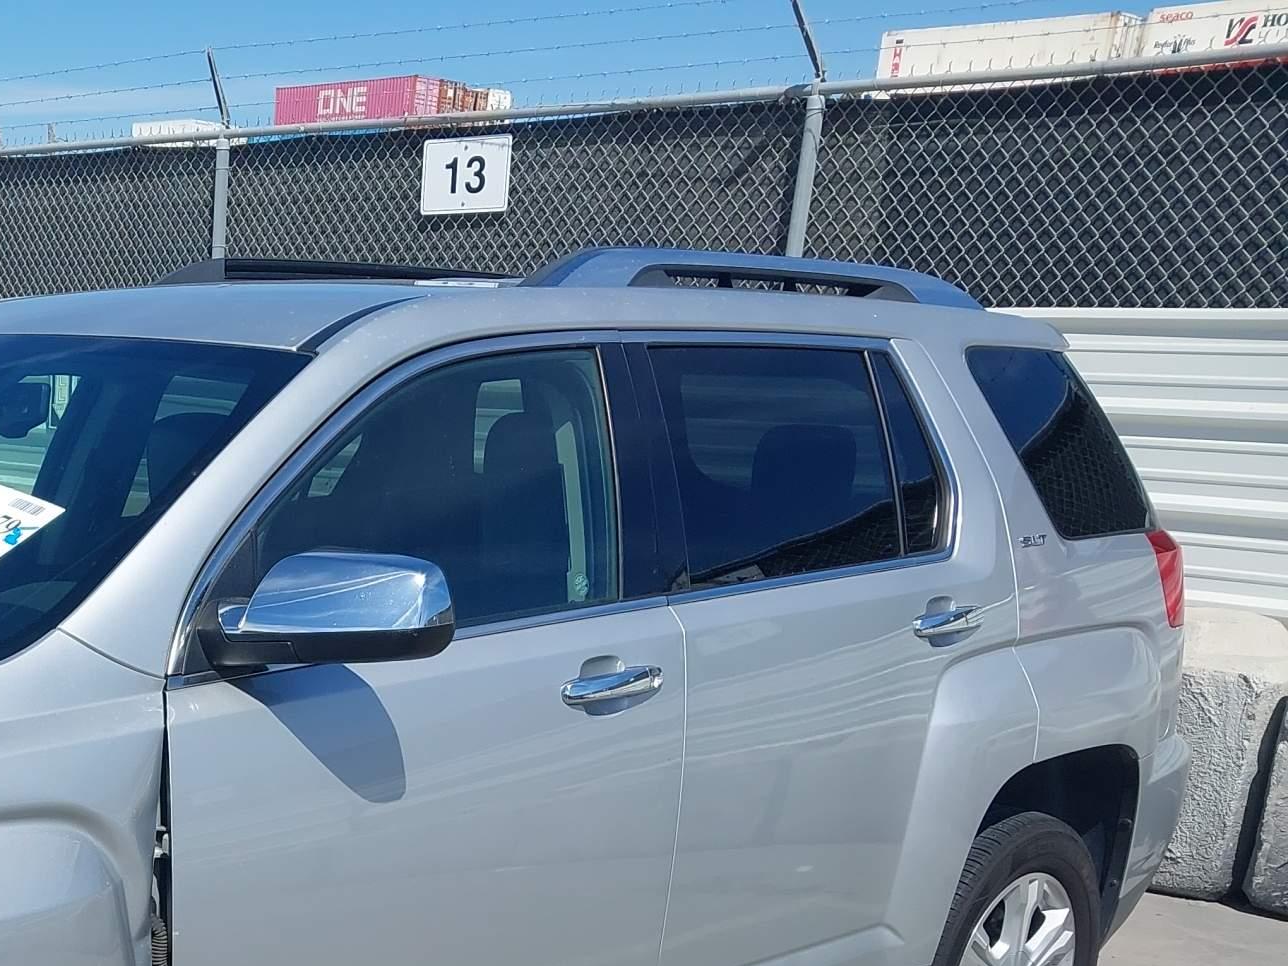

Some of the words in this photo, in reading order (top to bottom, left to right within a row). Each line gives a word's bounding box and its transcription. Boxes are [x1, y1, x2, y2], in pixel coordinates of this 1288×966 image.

[1158, 11, 1194, 24] seaco
[317, 86, 368, 115] ONE
[445, 155, 486, 194] 13
[1019, 534, 1048, 549] SLT
